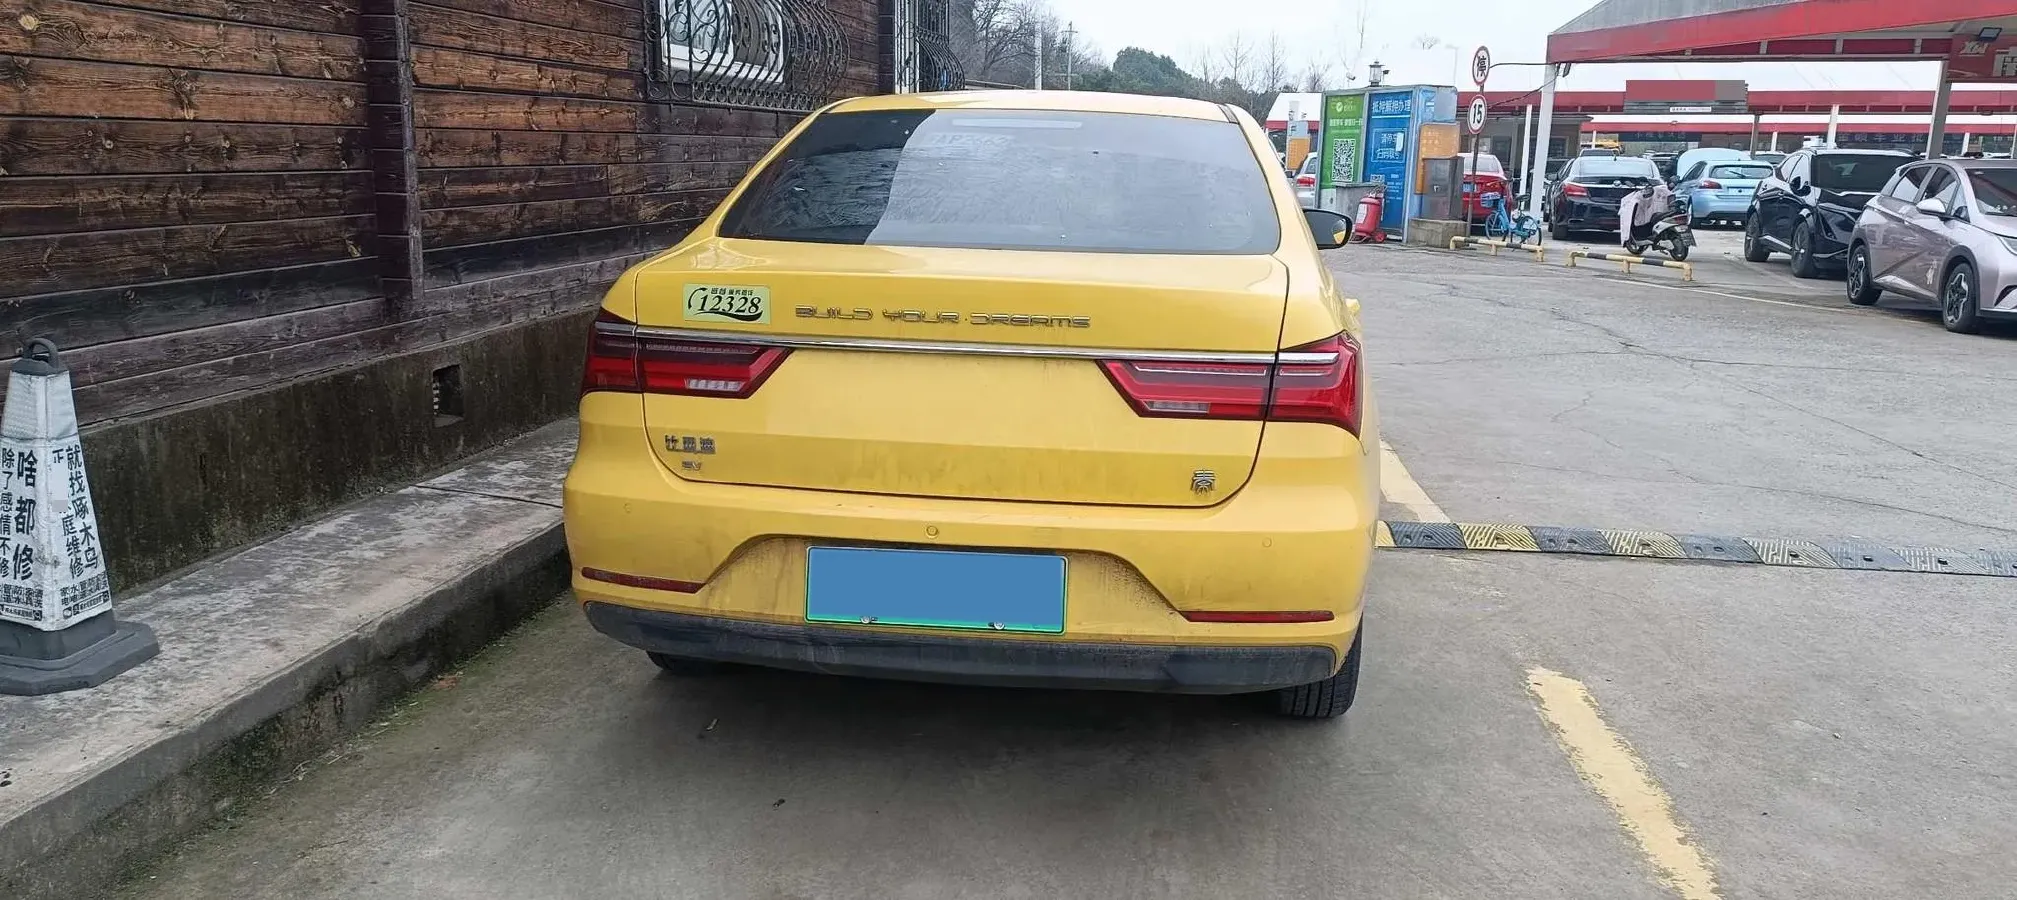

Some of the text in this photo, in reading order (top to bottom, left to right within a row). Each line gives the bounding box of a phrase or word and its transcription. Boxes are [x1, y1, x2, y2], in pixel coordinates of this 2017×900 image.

[1473, 103, 1483, 124] 15
[698, 294, 762, 314] 12328
[795, 304, 1090, 328] BUILD YOUR DREAMS
[12, 449, 38, 581] 啥都修
[65, 444, 98, 569] 就找啄木鸟
